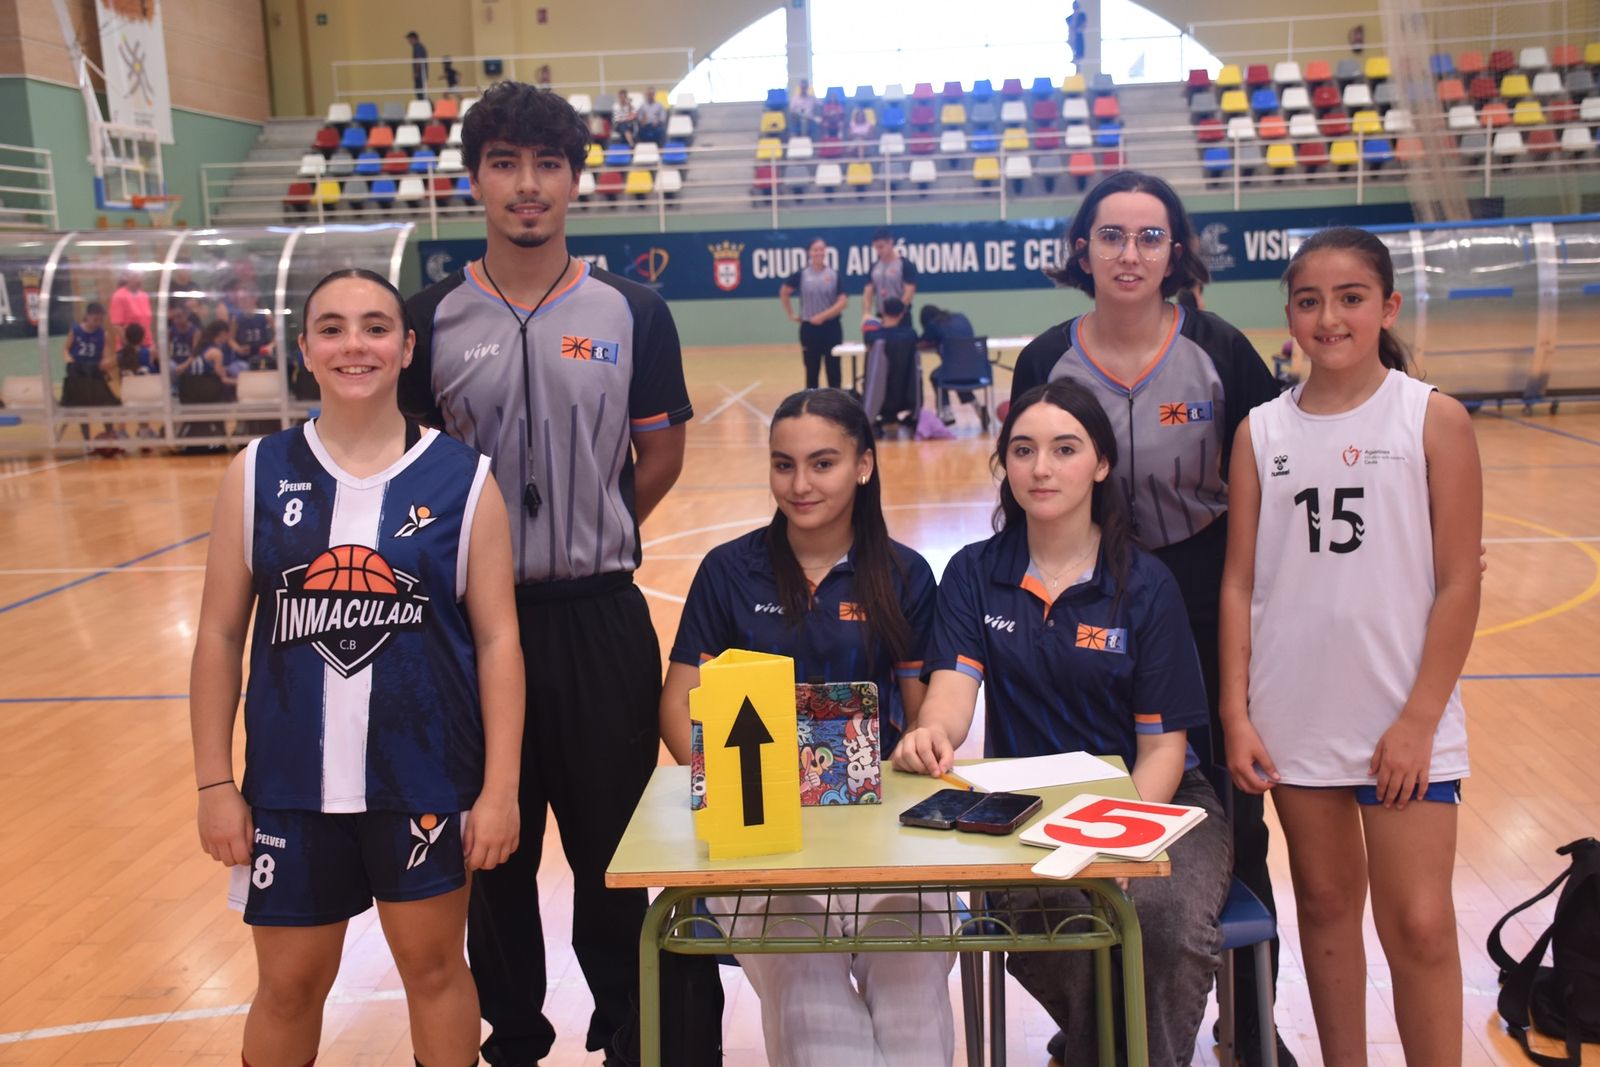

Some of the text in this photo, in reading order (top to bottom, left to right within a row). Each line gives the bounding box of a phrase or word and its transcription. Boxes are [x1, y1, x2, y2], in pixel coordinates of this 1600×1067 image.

[752, 237, 1070, 279] CIUDD AUÓNOMA DE CEU
[1243, 229, 1290, 261] VISI
[282, 497, 304, 527] 8
[1294, 487, 1365, 554] 15
[281, 598, 423, 642] INMACULADA
[339, 639, 357, 650] C.B
[1043, 798, 1191, 849] 5
[252, 853, 275, 890] 8
